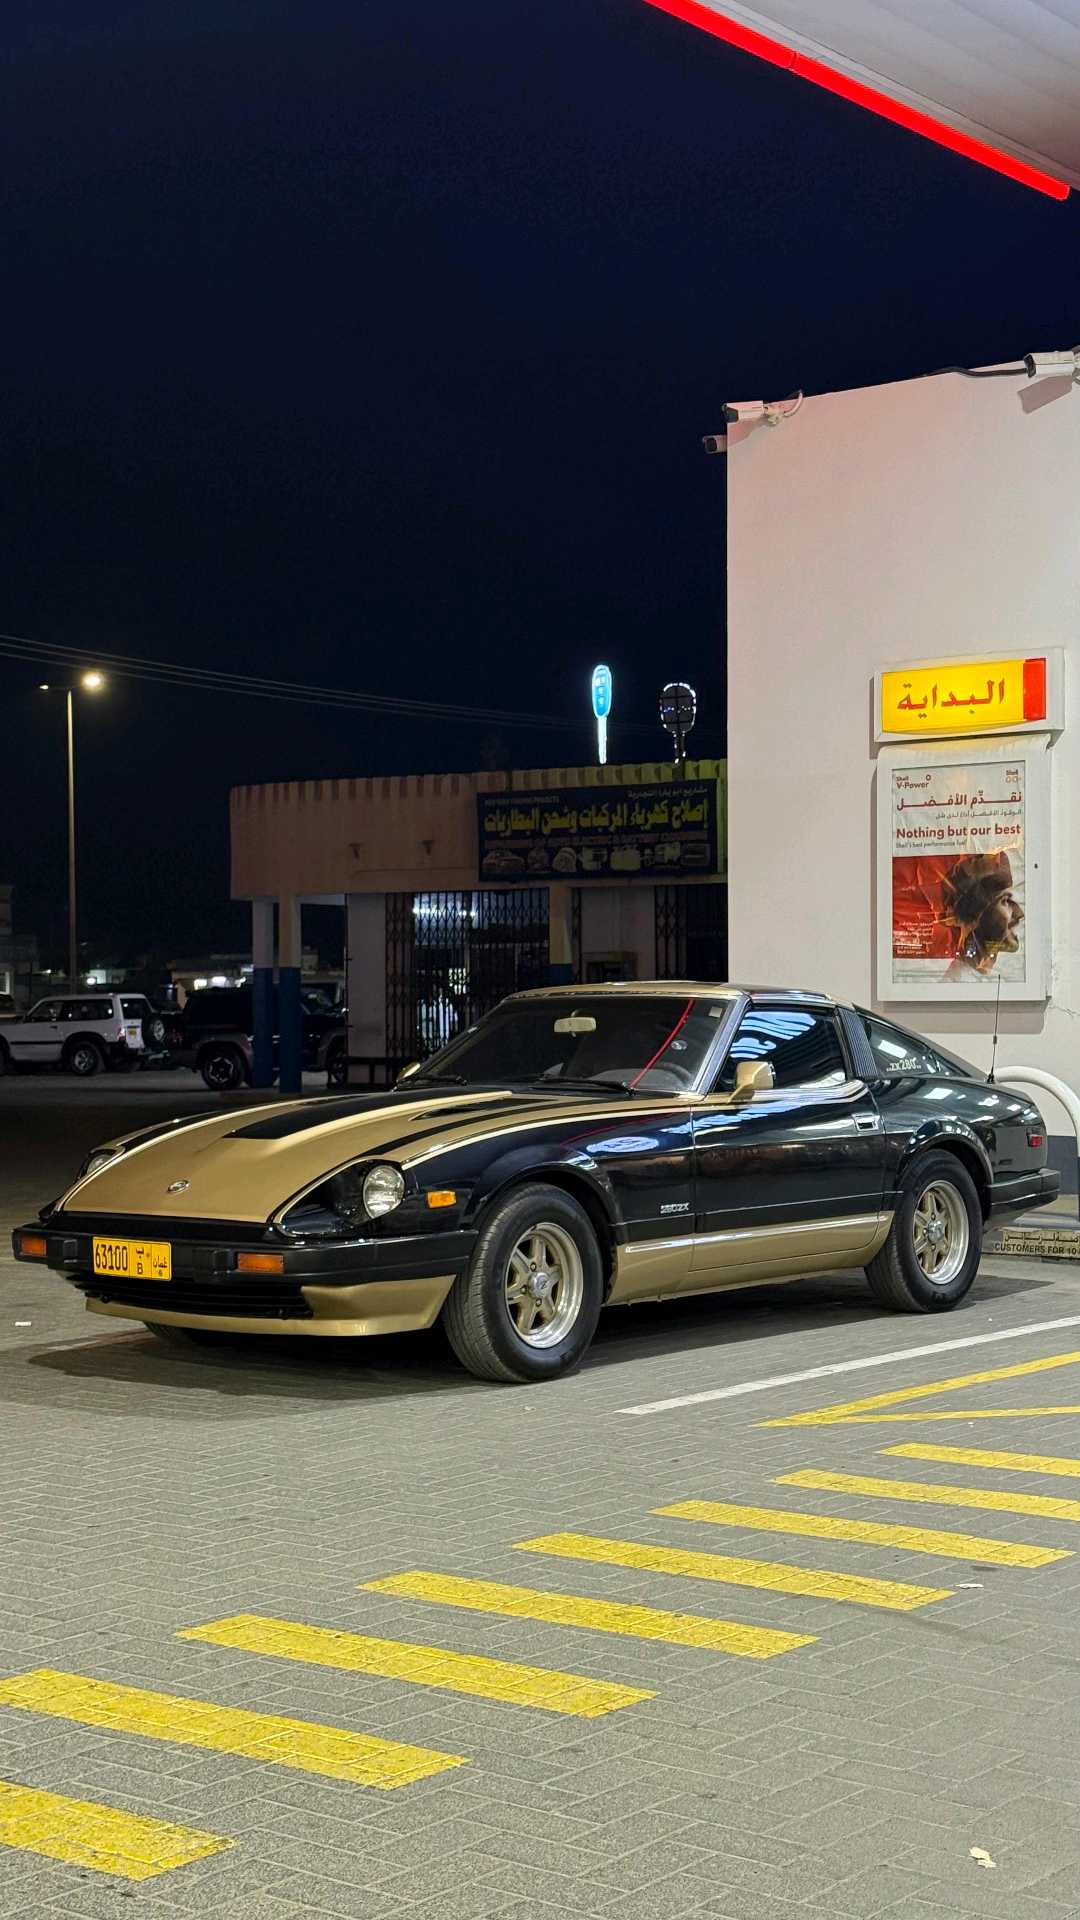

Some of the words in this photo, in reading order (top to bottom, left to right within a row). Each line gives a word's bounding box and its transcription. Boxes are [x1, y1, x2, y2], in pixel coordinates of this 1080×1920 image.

[897, 678, 1005, 719] البداية
[896, 826, 945, 840] Nothing
[947, 825, 967, 837] but
[970, 826, 992, 836] our
[994, 823, 1021, 835] best
[95, 1243, 128, 1271] 63100
[994, 1243, 1045, 1254] CUSTOMERS
[1047, 1246, 1065, 1255] FOR
[1068, 1247, 1077, 1255] 10
[137, 1262, 144, 1275] B
